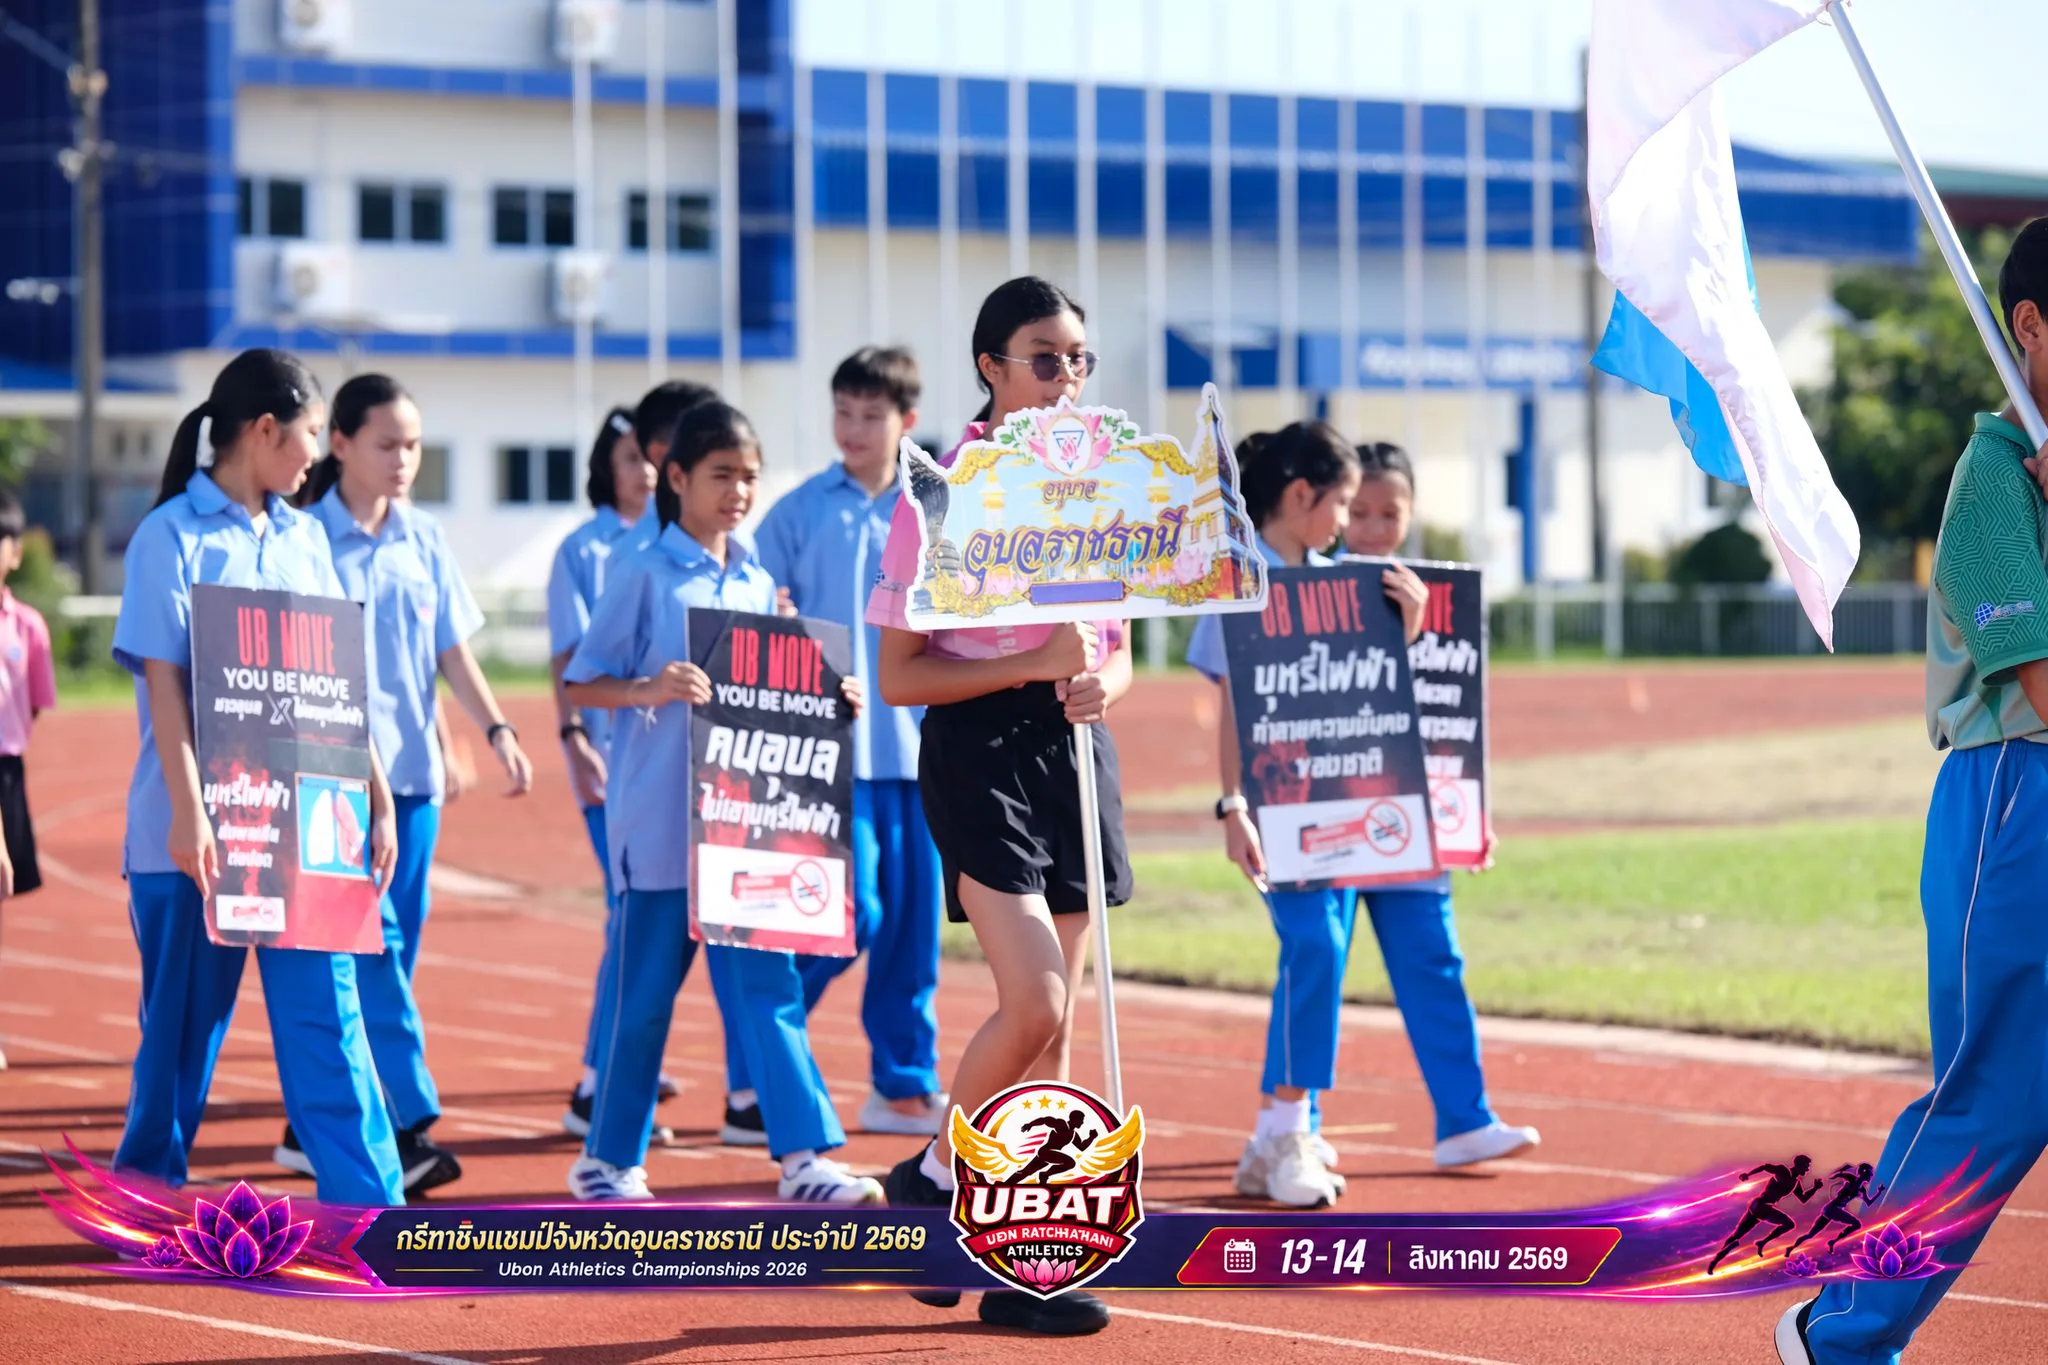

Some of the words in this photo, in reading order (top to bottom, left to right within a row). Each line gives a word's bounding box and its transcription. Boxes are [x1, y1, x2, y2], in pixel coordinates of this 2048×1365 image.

[1041, 479, 1099, 511] อนุบาล
[963, 505, 1188, 597] อุบลราชธานี
[236, 606, 269, 668] UB
[280, 610, 336, 676] MOVE
[1297, 578, 1365, 636] MOVE
[223, 667, 268, 692] YOU
[272, 670, 297, 695] BE
[300, 674, 350, 700] MOVE
[731, 627, 760, 687] UB
[768, 633, 824, 696] MOVE
[1254, 640, 1397, 714] บุหรี่ไฟฟ้า
[715, 683, 755, 709] YOU
[758, 688, 782, 713] BE
[783, 692, 837, 720] MOVE
[705, 725, 841, 800] คนอุบล
